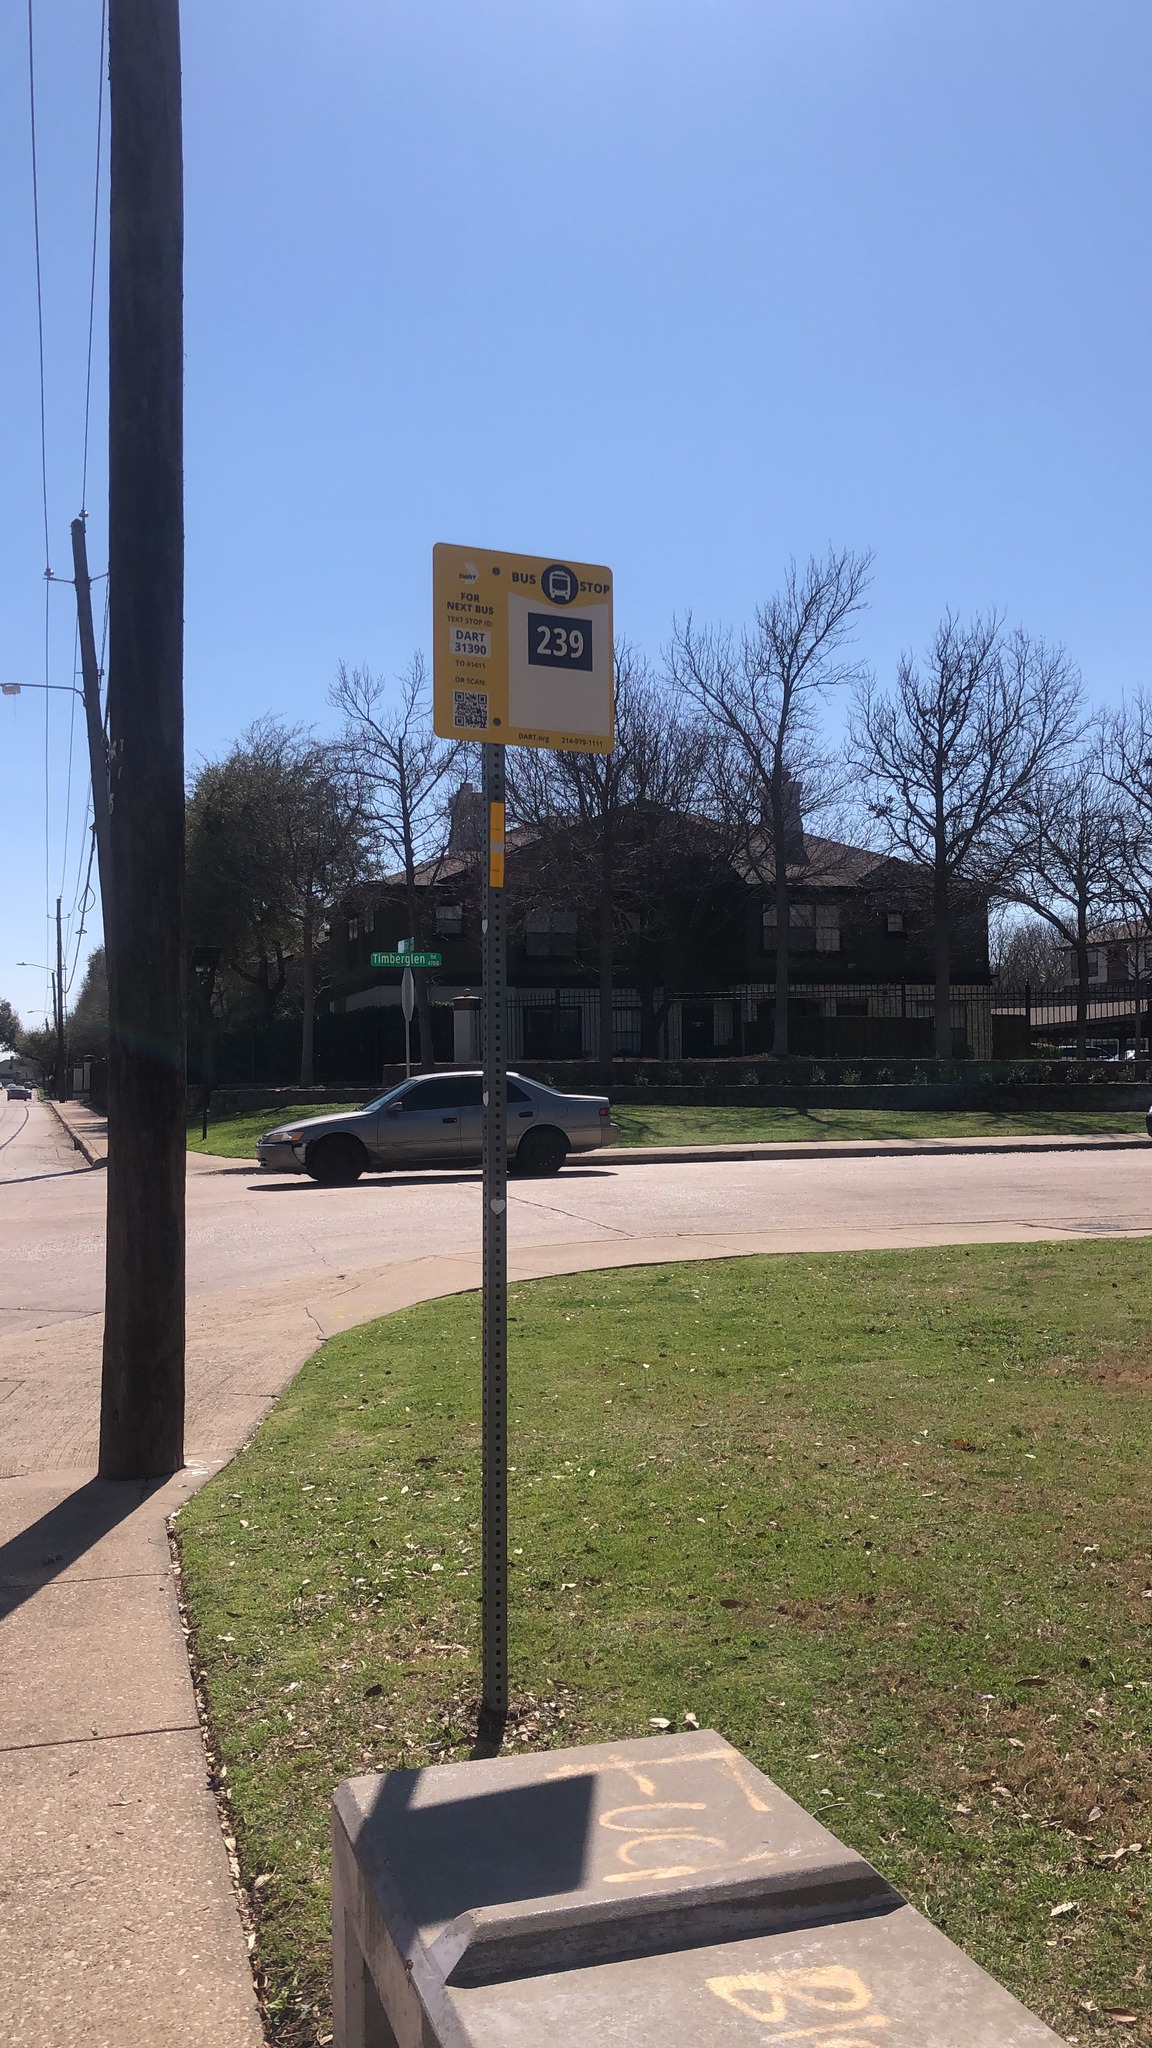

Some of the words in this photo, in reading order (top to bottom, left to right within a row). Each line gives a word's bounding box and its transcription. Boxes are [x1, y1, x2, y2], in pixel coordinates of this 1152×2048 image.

[511, 571, 537, 585] BUS
[580, 581, 610, 595] STOP
[461, 592, 480, 603] FOR
[446, 601, 473, 612] NEXT
[475, 604, 494, 615] BUS
[447, 615, 463, 623] TEXT
[465, 617, 483, 626] STOP
[456, 629, 486, 643] DART
[536, 625, 584, 659] 239
[454, 642, 487, 656] 31390
[455, 659, 466, 668] TO
[466, 660, 487, 669] 41411
[455, 676, 465, 684] OR
[518, 733, 550, 744] DART.org
[373, 953, 426, 966] Timberglen
